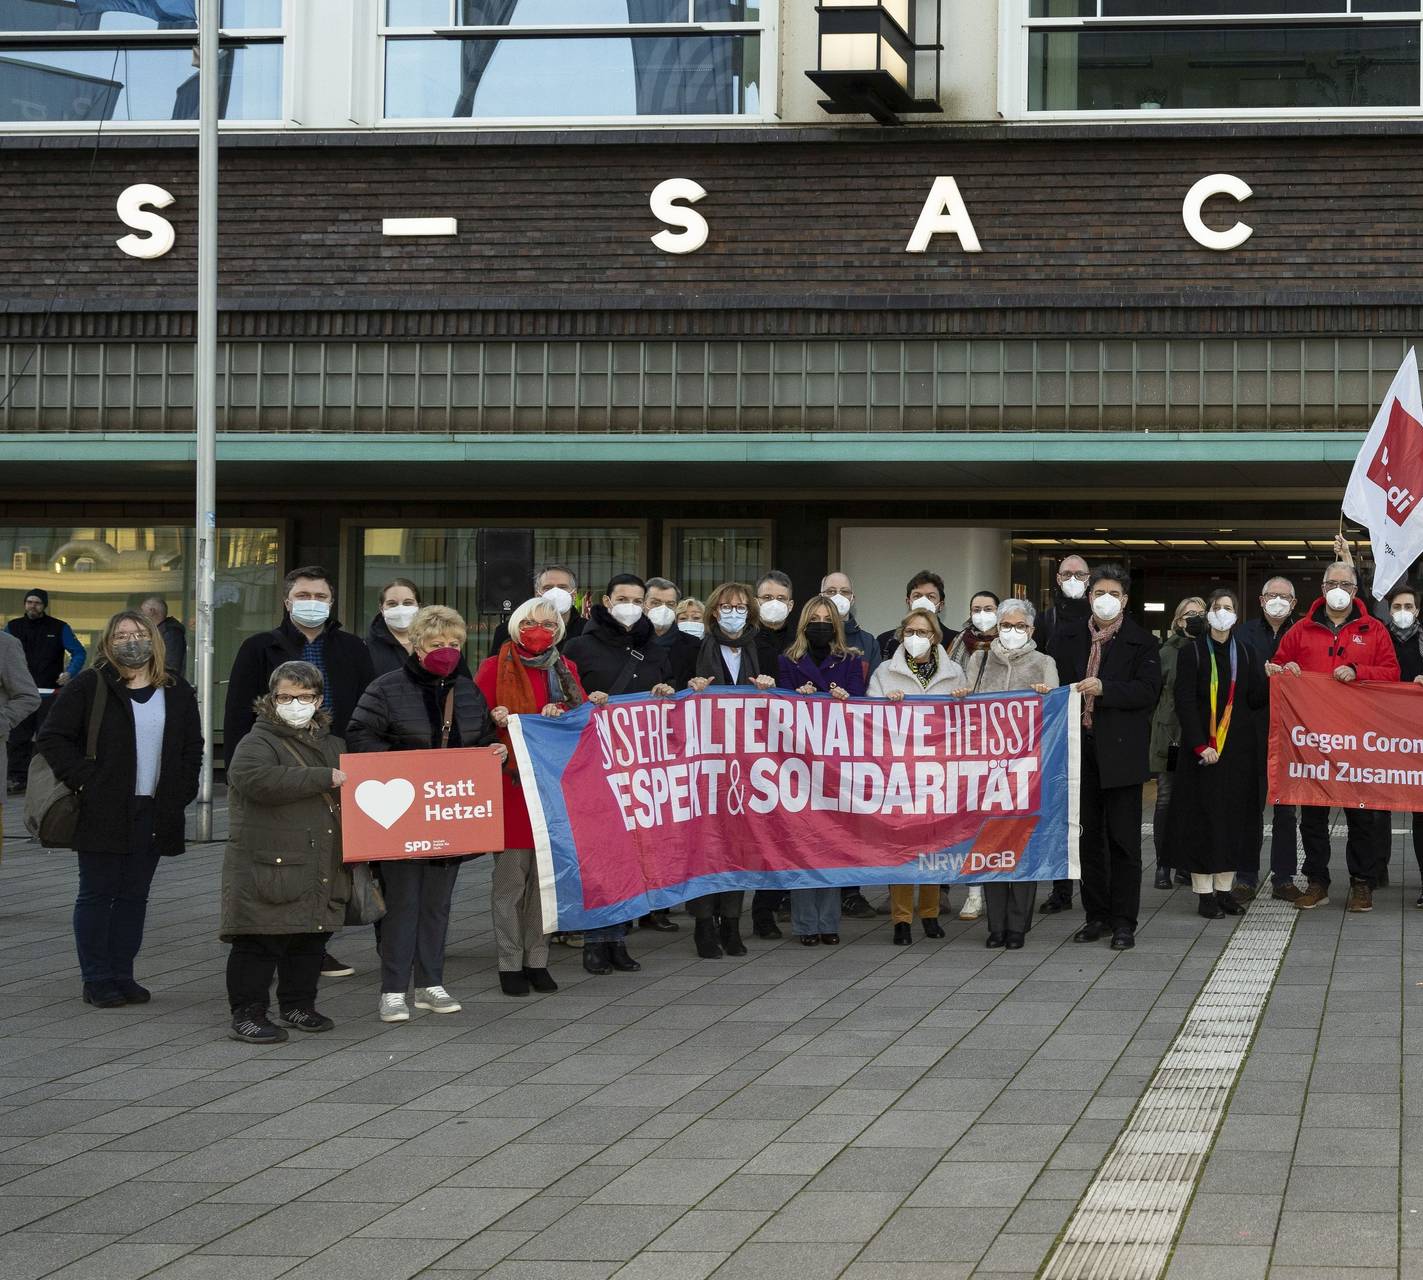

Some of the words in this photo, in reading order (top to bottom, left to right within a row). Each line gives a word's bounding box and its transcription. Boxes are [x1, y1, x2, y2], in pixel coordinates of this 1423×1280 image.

[684, 698, 936, 758] ALTERNATIVE
[944, 700, 1040, 756] HEISST
[1291, 725, 1357, 753] Gegen
[1288, 759, 1330, 781] und
[424, 780, 475, 799] Statt
[606, 760, 727, 832] ESPEKT
[748, 757, 1038, 815] SOLIDARITÄT
[425, 800, 493, 822] Hetze!
[404, 840, 432, 853] SPD
[917, 851, 970, 873] NRW
[970, 850, 1016, 872] DGB
